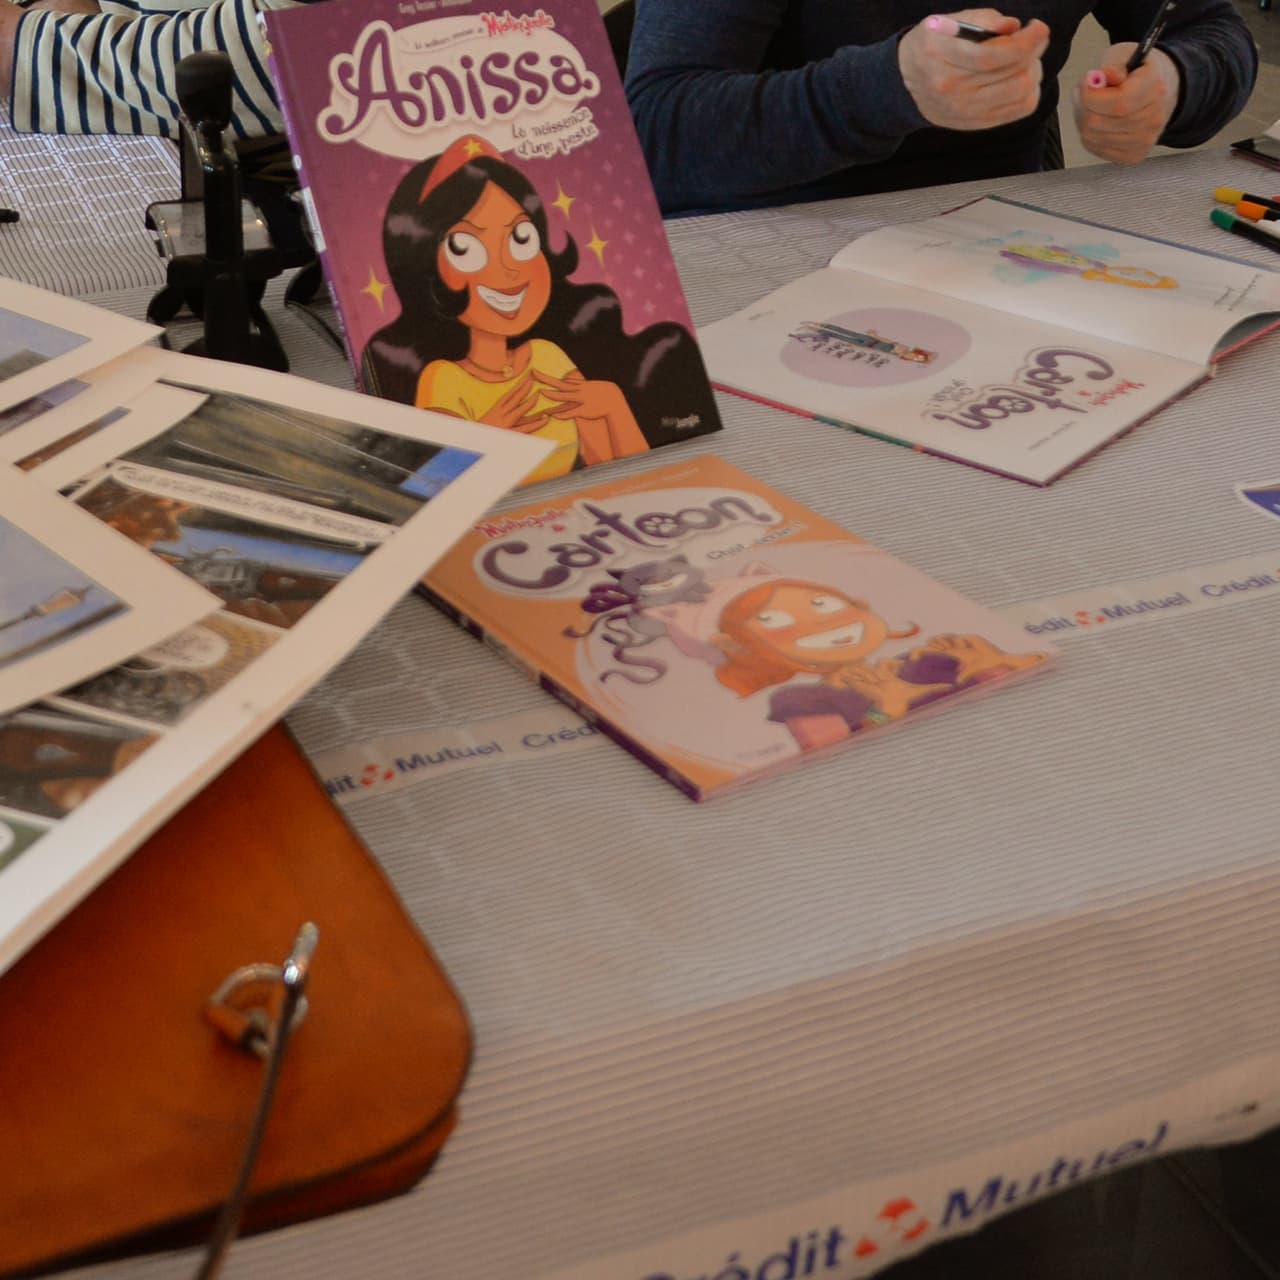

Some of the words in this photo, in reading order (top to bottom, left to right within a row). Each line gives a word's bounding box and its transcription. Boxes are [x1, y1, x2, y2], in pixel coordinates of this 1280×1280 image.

[325, 27, 593, 136] Anissa
[558, 124, 597, 151] peste
[932, 349, 1115, 431] Cartoon
[482, 496, 773, 590] Cartoon
[1200, 573, 1280, 598] Crédit
[1023, 616, 1075, 636] édit
[1100, 591, 1192, 620] Mutuel
[521, 718, 603, 750] Créd
[394, 741, 504, 773] Mutuel
[639, 1226, 846, 1280] rédit
